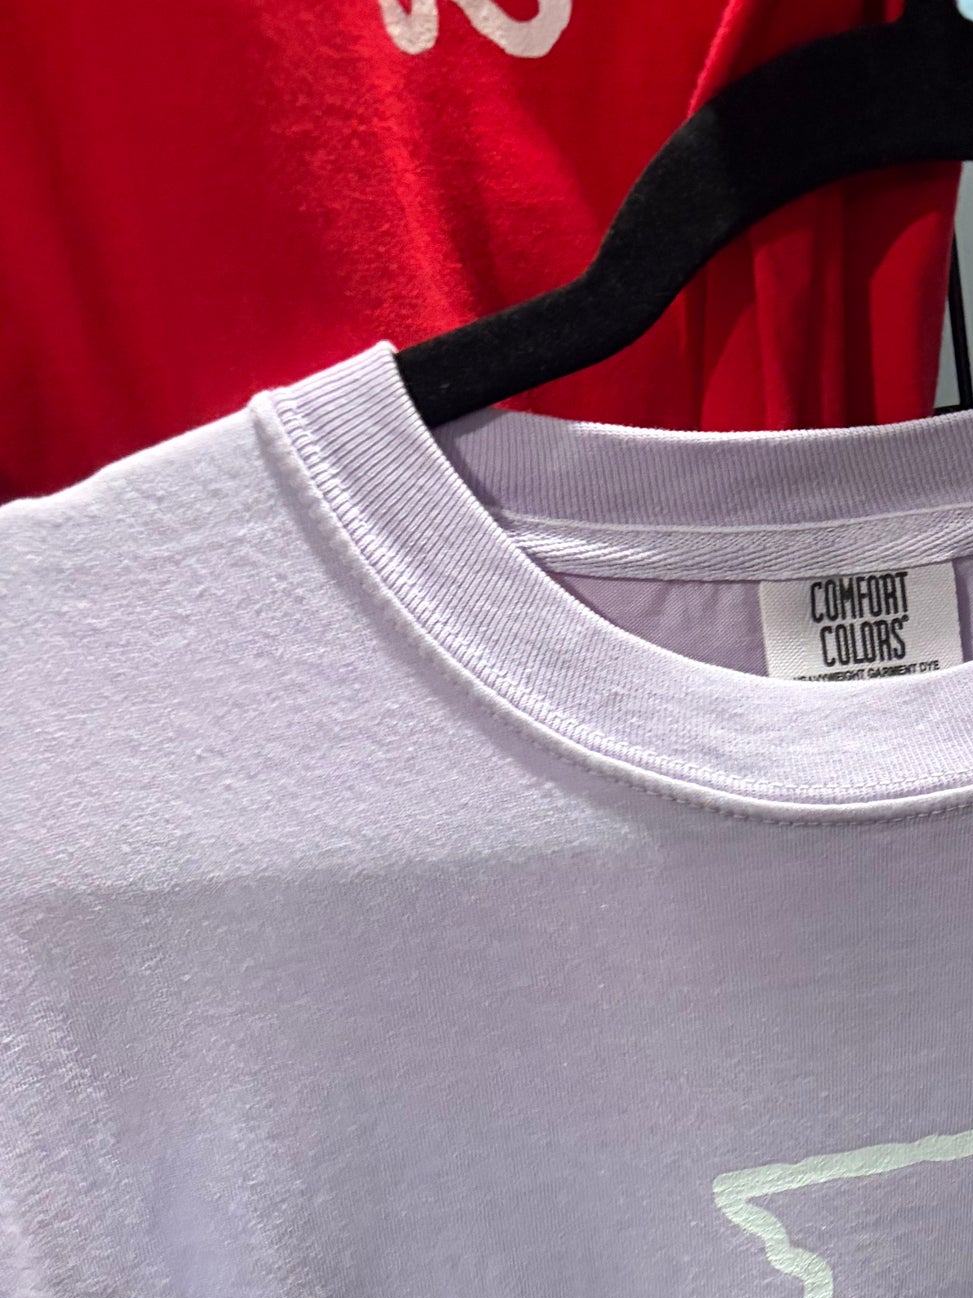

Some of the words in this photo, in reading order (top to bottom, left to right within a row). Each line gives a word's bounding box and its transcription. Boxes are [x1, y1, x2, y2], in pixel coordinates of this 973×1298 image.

[810, 571, 908, 623] COMFORT
[820, 618, 907, 667] COLORS
[919, 660, 940, 673] DYE
